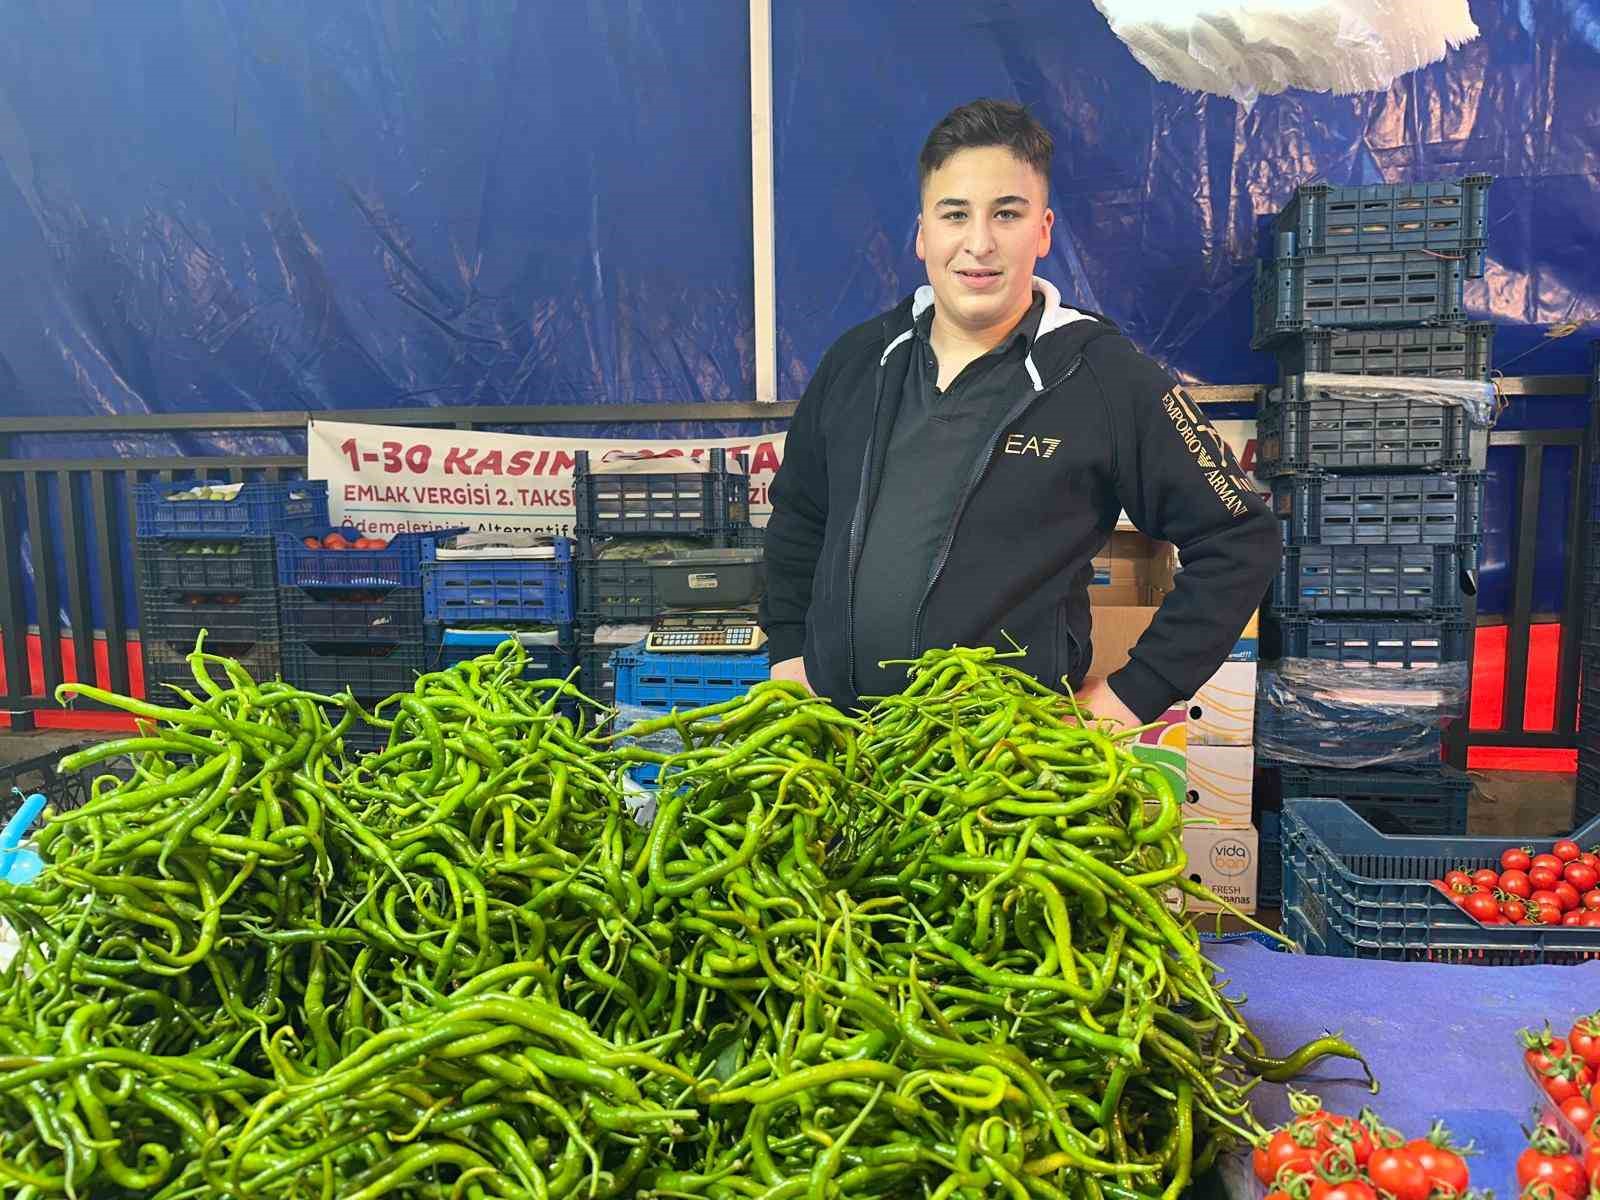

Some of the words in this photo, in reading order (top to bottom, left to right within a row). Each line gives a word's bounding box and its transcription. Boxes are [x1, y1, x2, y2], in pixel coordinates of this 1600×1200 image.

[1162, 392, 1202, 453] EMPORIO
[340, 438, 432, 474] 1-30
[1004, 434, 1062, 458] EA7
[344, 484, 410, 503] EMLAK
[413, 483, 489, 505] VERGİSİ
[496, 489, 513, 506] 2.
[1215, 844, 1246, 858] vida
[1211, 885, 1241, 895] FRESH
